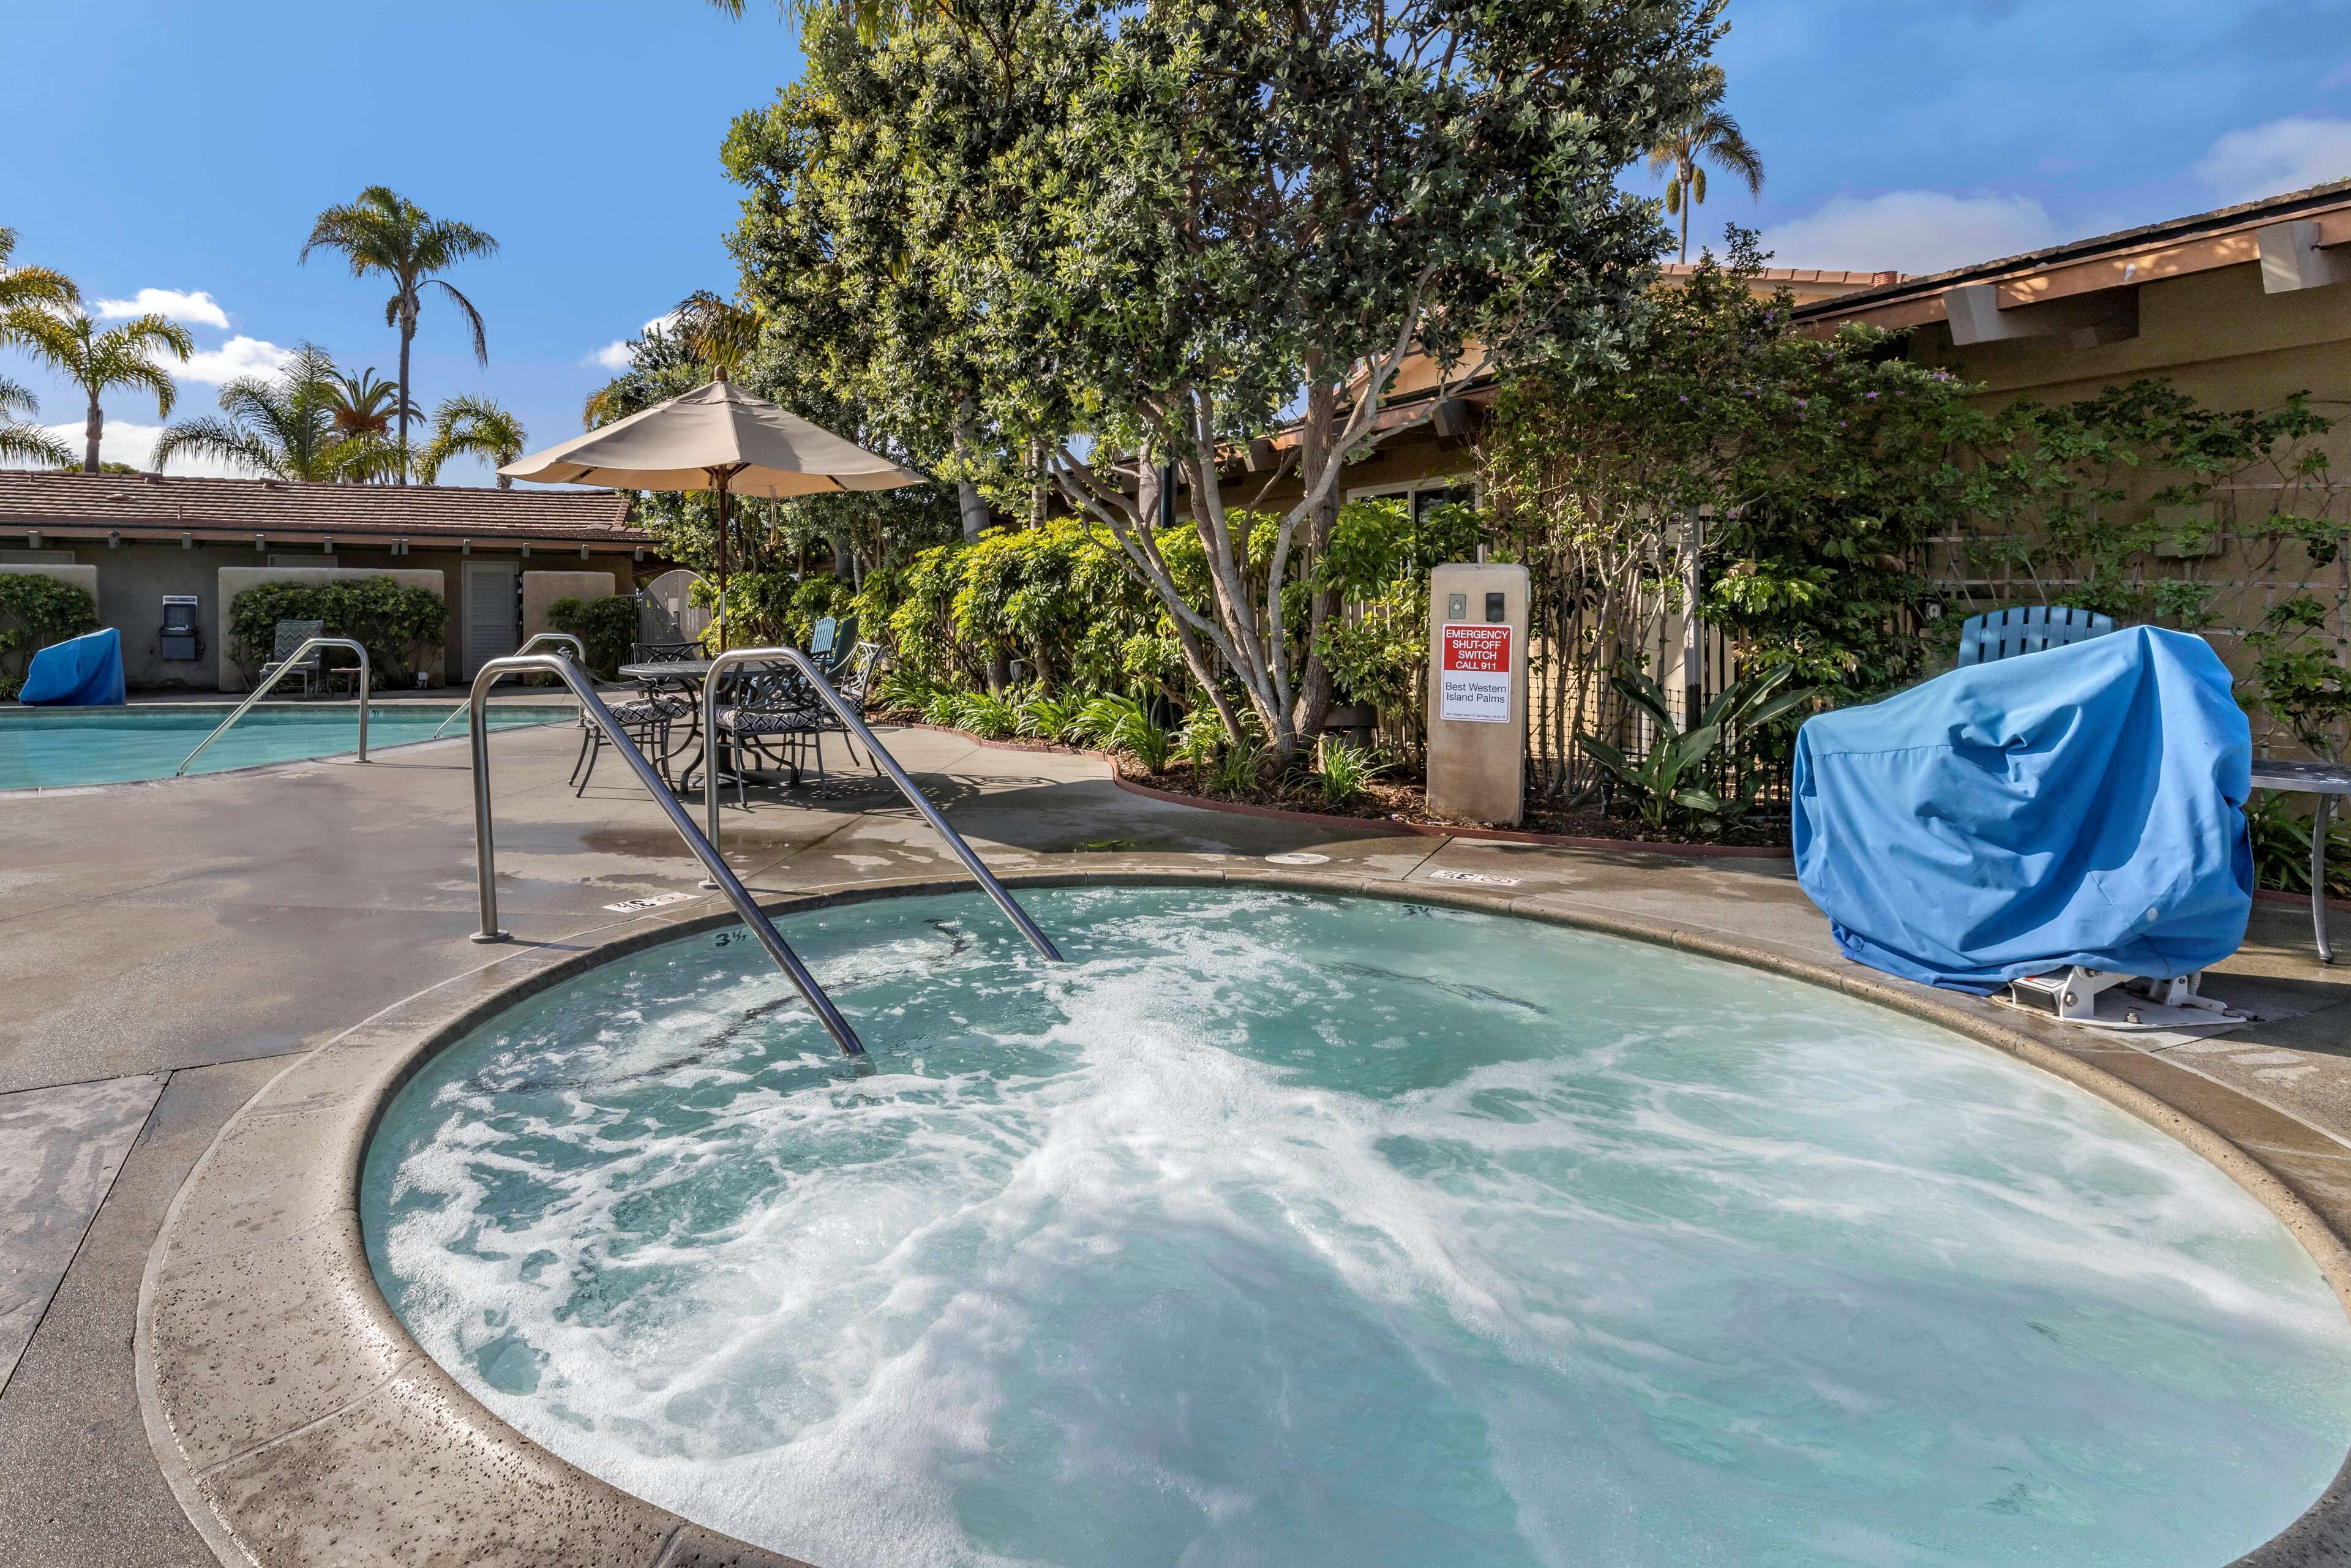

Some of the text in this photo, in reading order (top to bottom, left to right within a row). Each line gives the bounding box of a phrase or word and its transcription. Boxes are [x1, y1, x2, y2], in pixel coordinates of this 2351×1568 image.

[1446, 629, 1509, 639] EMERGENCY
[1452, 640, 1501, 649] SHUT-OFF
[1458, 650, 1497, 660] SWITCH
[1455, 661, 1479, 669] CALL
[1445, 681, 1507, 693] Best Western
[1447, 692, 1505, 703] Island Palms
